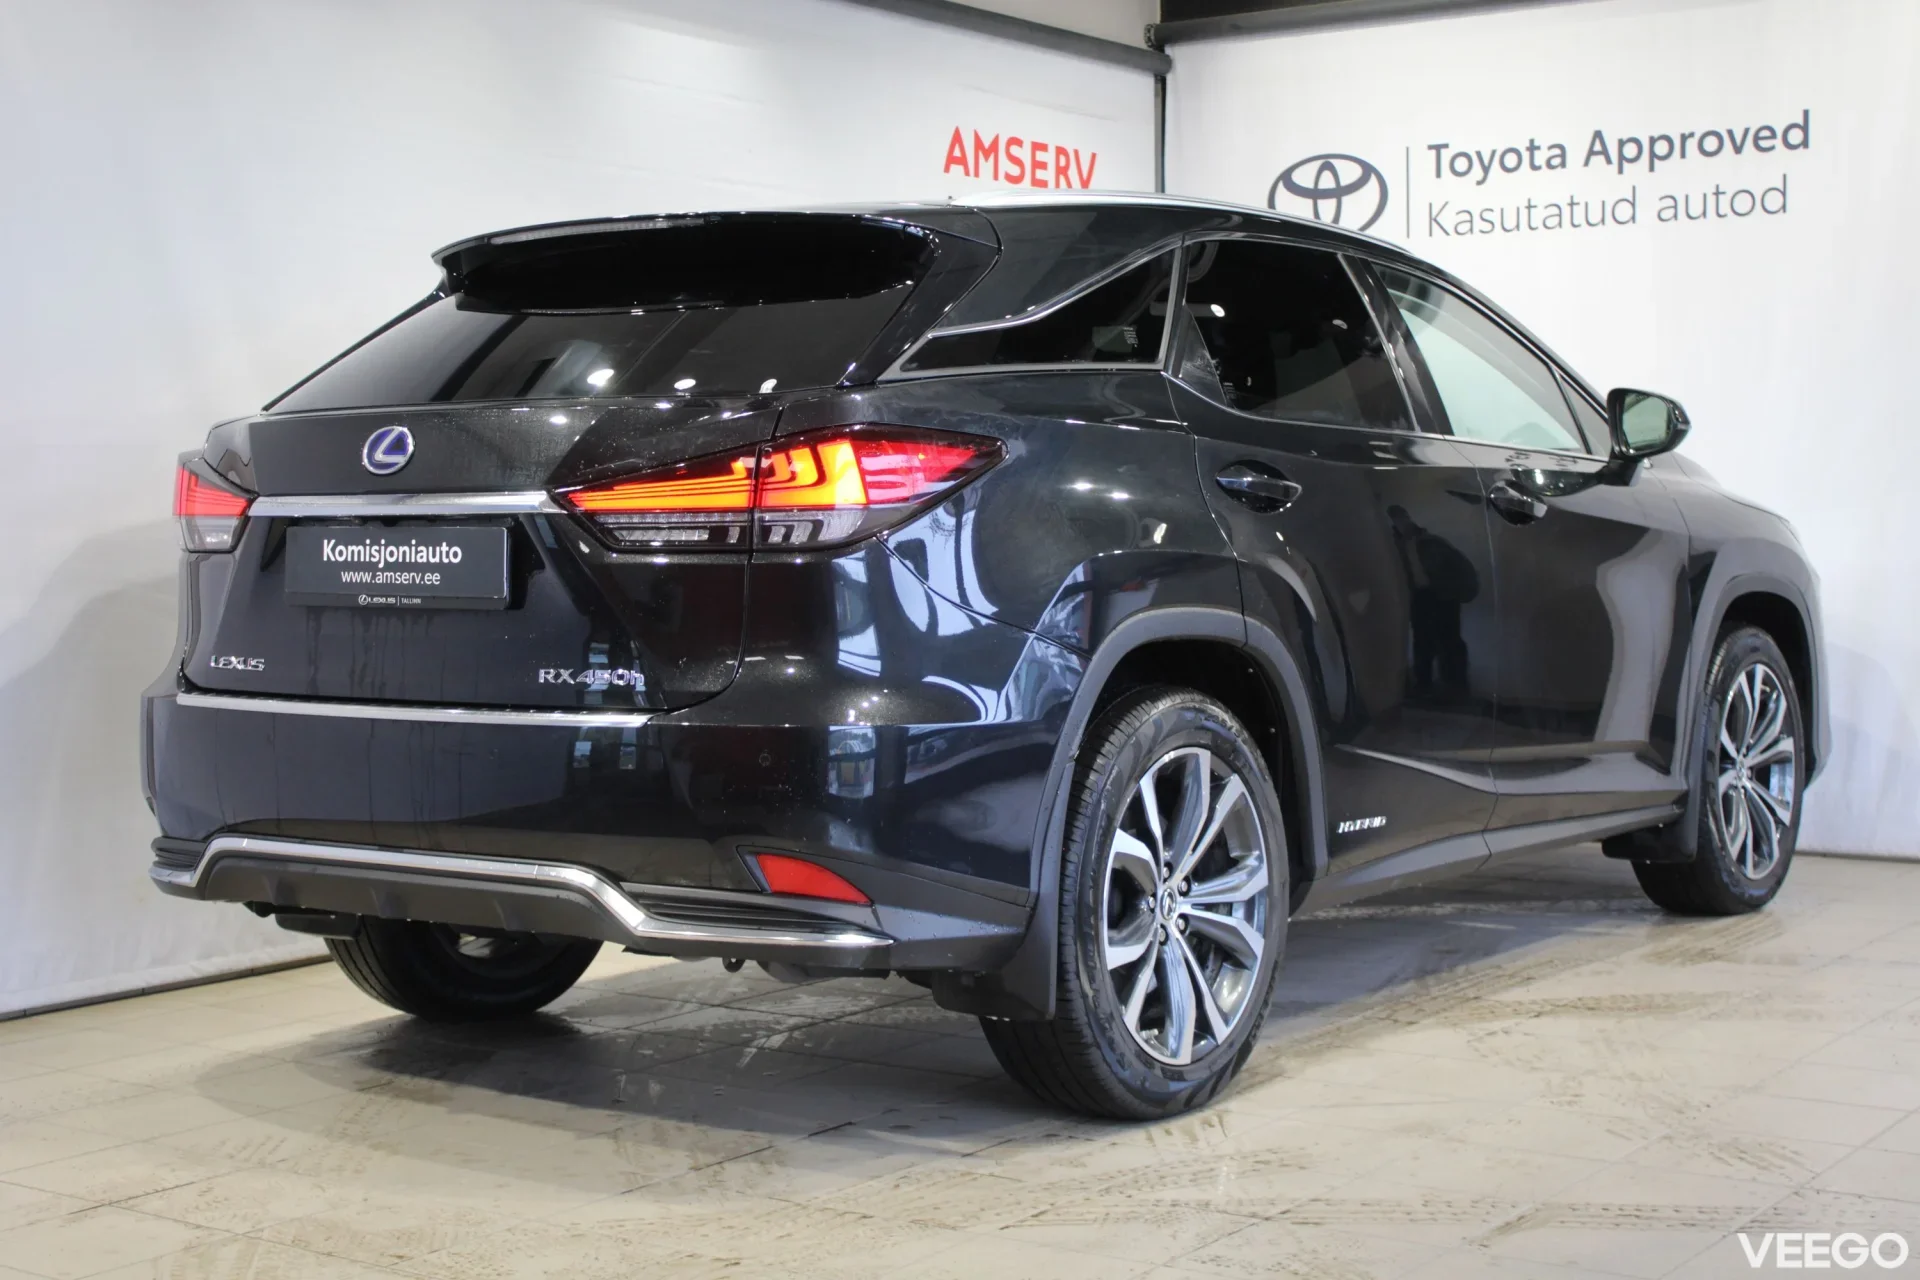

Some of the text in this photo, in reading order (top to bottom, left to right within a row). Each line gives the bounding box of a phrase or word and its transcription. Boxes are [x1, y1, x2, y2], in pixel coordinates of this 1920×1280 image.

[943, 125, 1097, 190] AMSERV
[1427, 109, 1811, 186] Toyota Approved
[1427, 173, 1788, 238] Kasutatud autod
[322, 538, 463, 568] Komisjoniauto
[341, 570, 441, 585] www.amserv.ee
[210, 655, 265, 671] LEXUS
